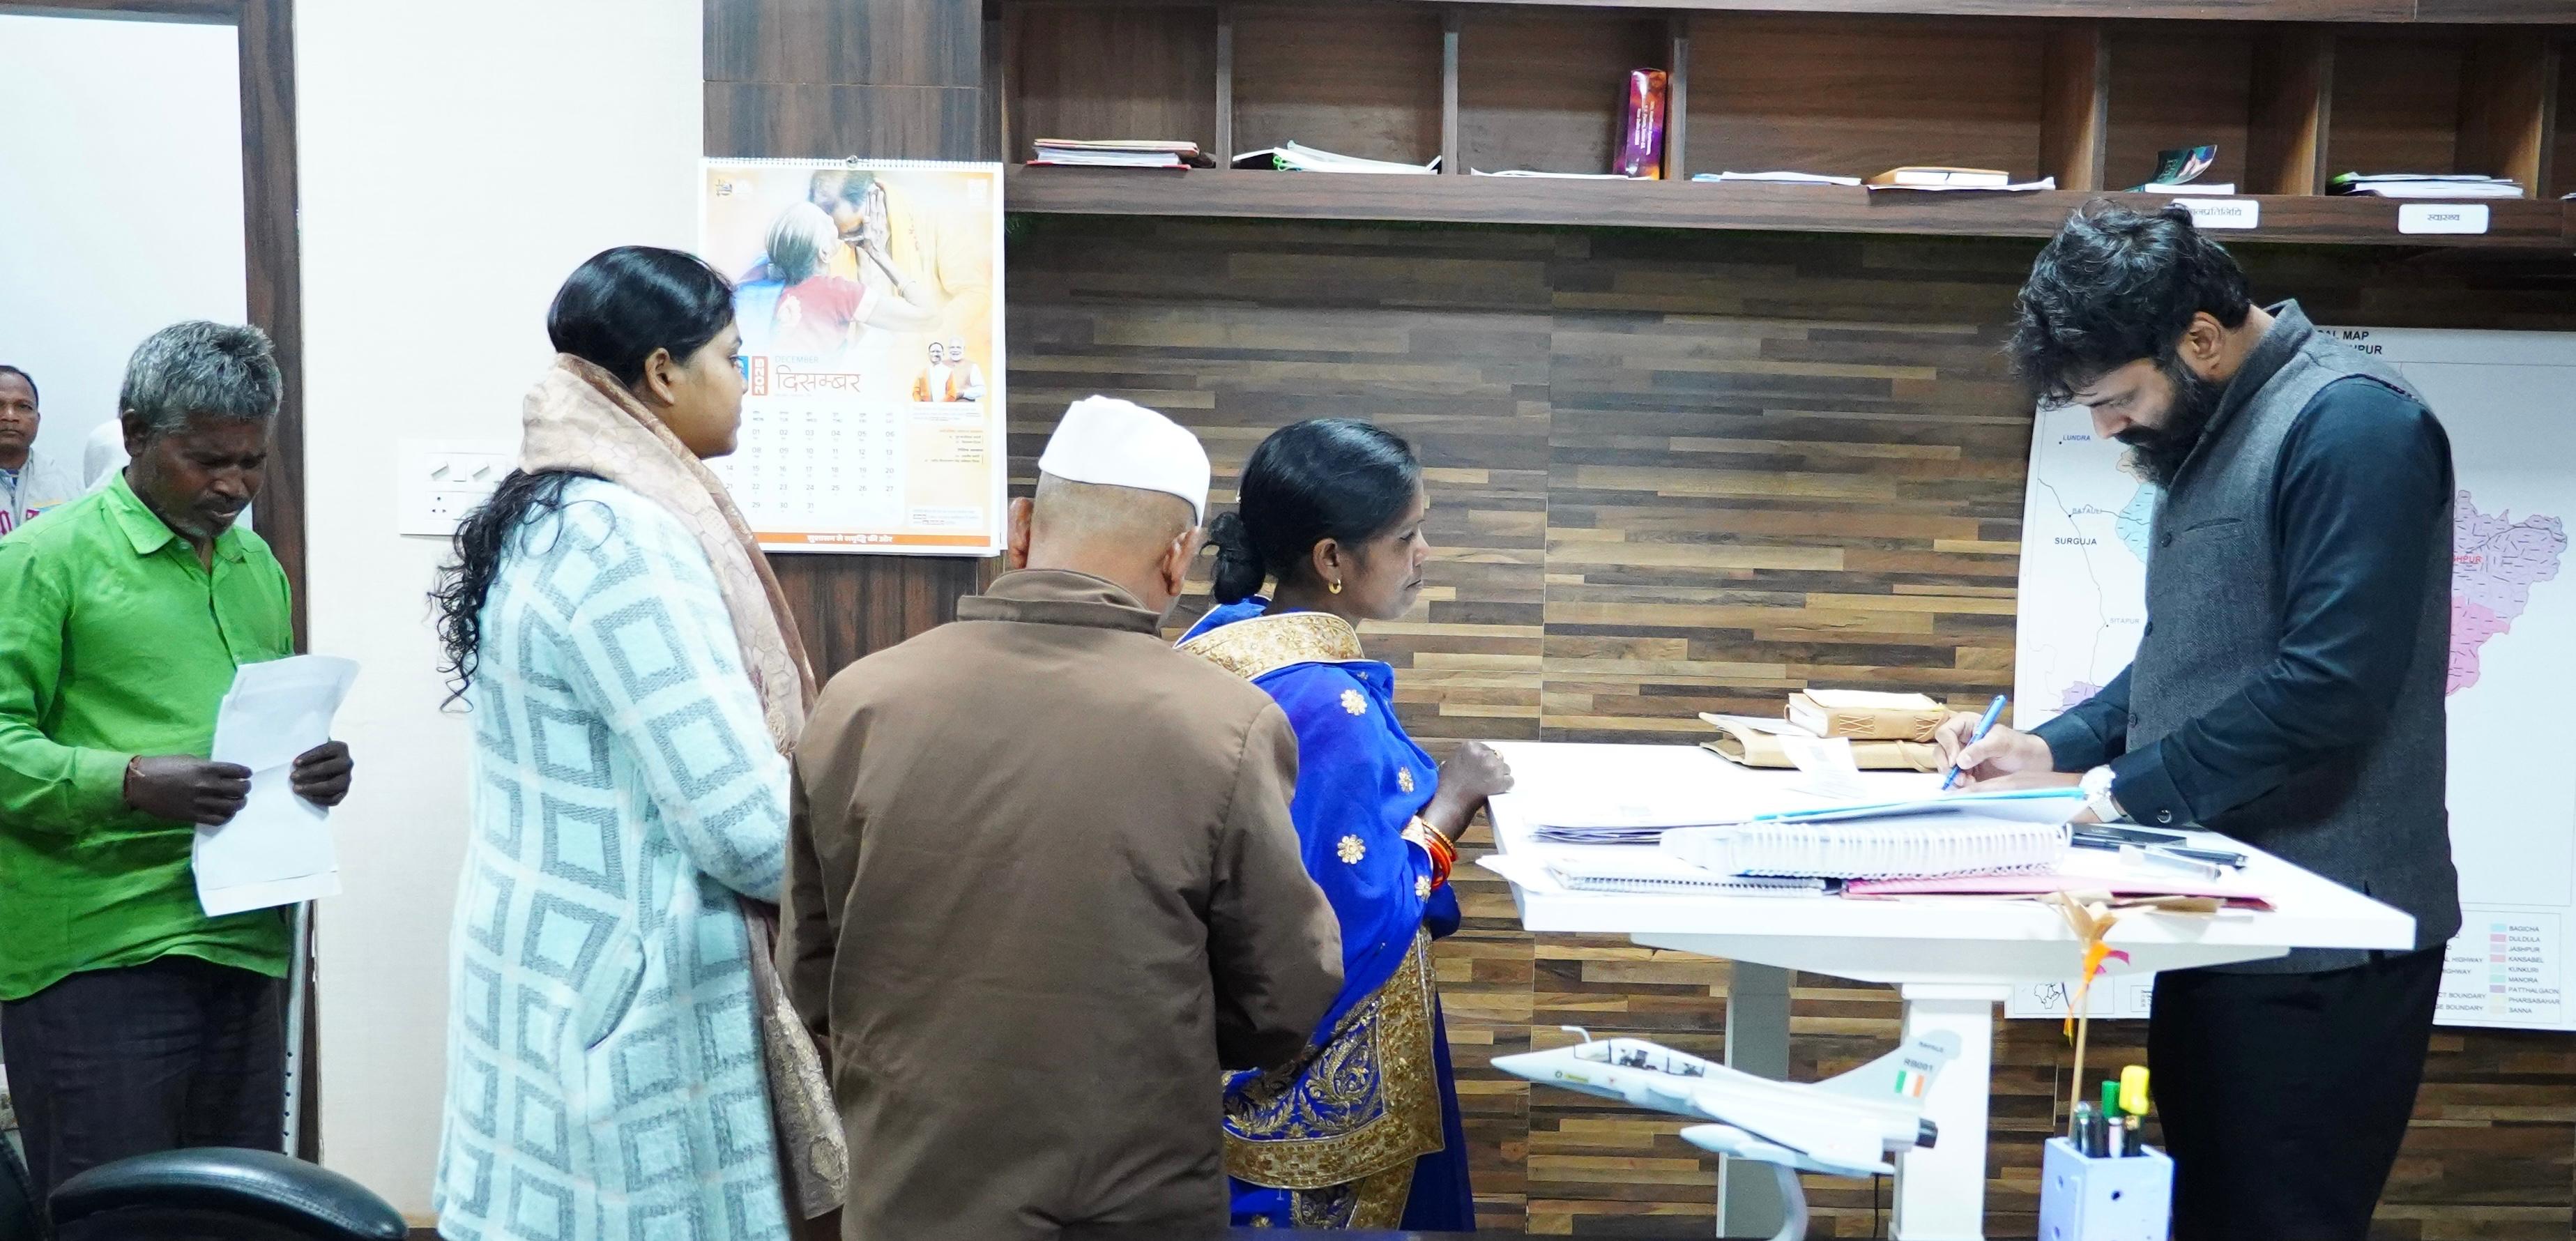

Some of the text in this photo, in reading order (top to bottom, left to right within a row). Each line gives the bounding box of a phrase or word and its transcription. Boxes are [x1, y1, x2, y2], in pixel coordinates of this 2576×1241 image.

[2192, 207, 2242, 216] नप्रतिनिधि
[2342, 330, 2369, 340] MAP
[754, 358, 765, 395] 2025
[775, 365, 862, 393] दिसम्बर
[2055, 537, 2097, 546] SURGUJA
